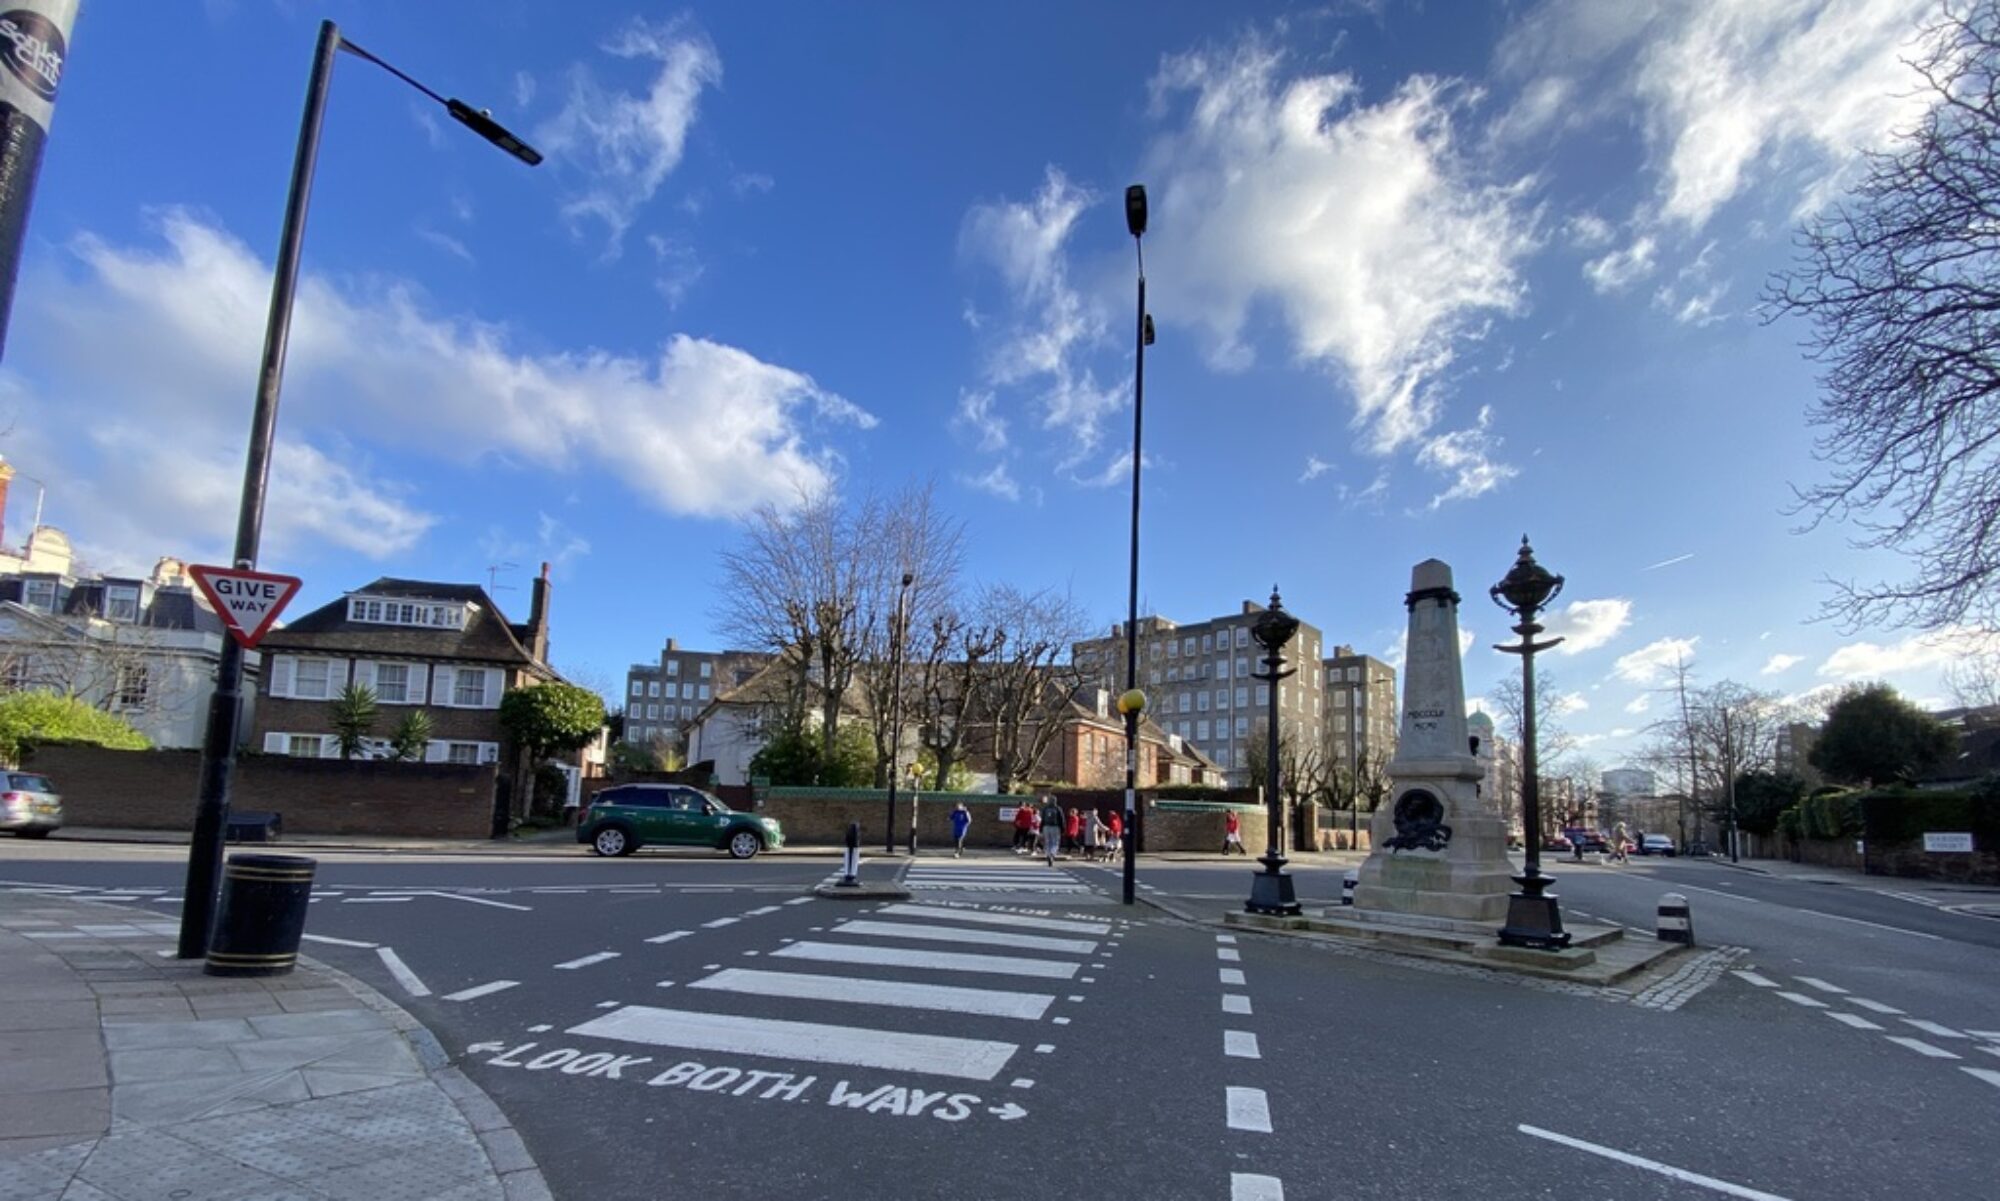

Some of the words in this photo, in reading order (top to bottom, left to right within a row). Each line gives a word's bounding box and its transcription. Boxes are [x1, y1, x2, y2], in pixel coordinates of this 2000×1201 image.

[215, 579, 277, 599] GIVE
[230, 599, 268, 613] WAY
[486, 1042, 653, 1079] LOOK
[646, 1062, 818, 1101] BOTH
[827, 1080, 982, 1121] WAYS
